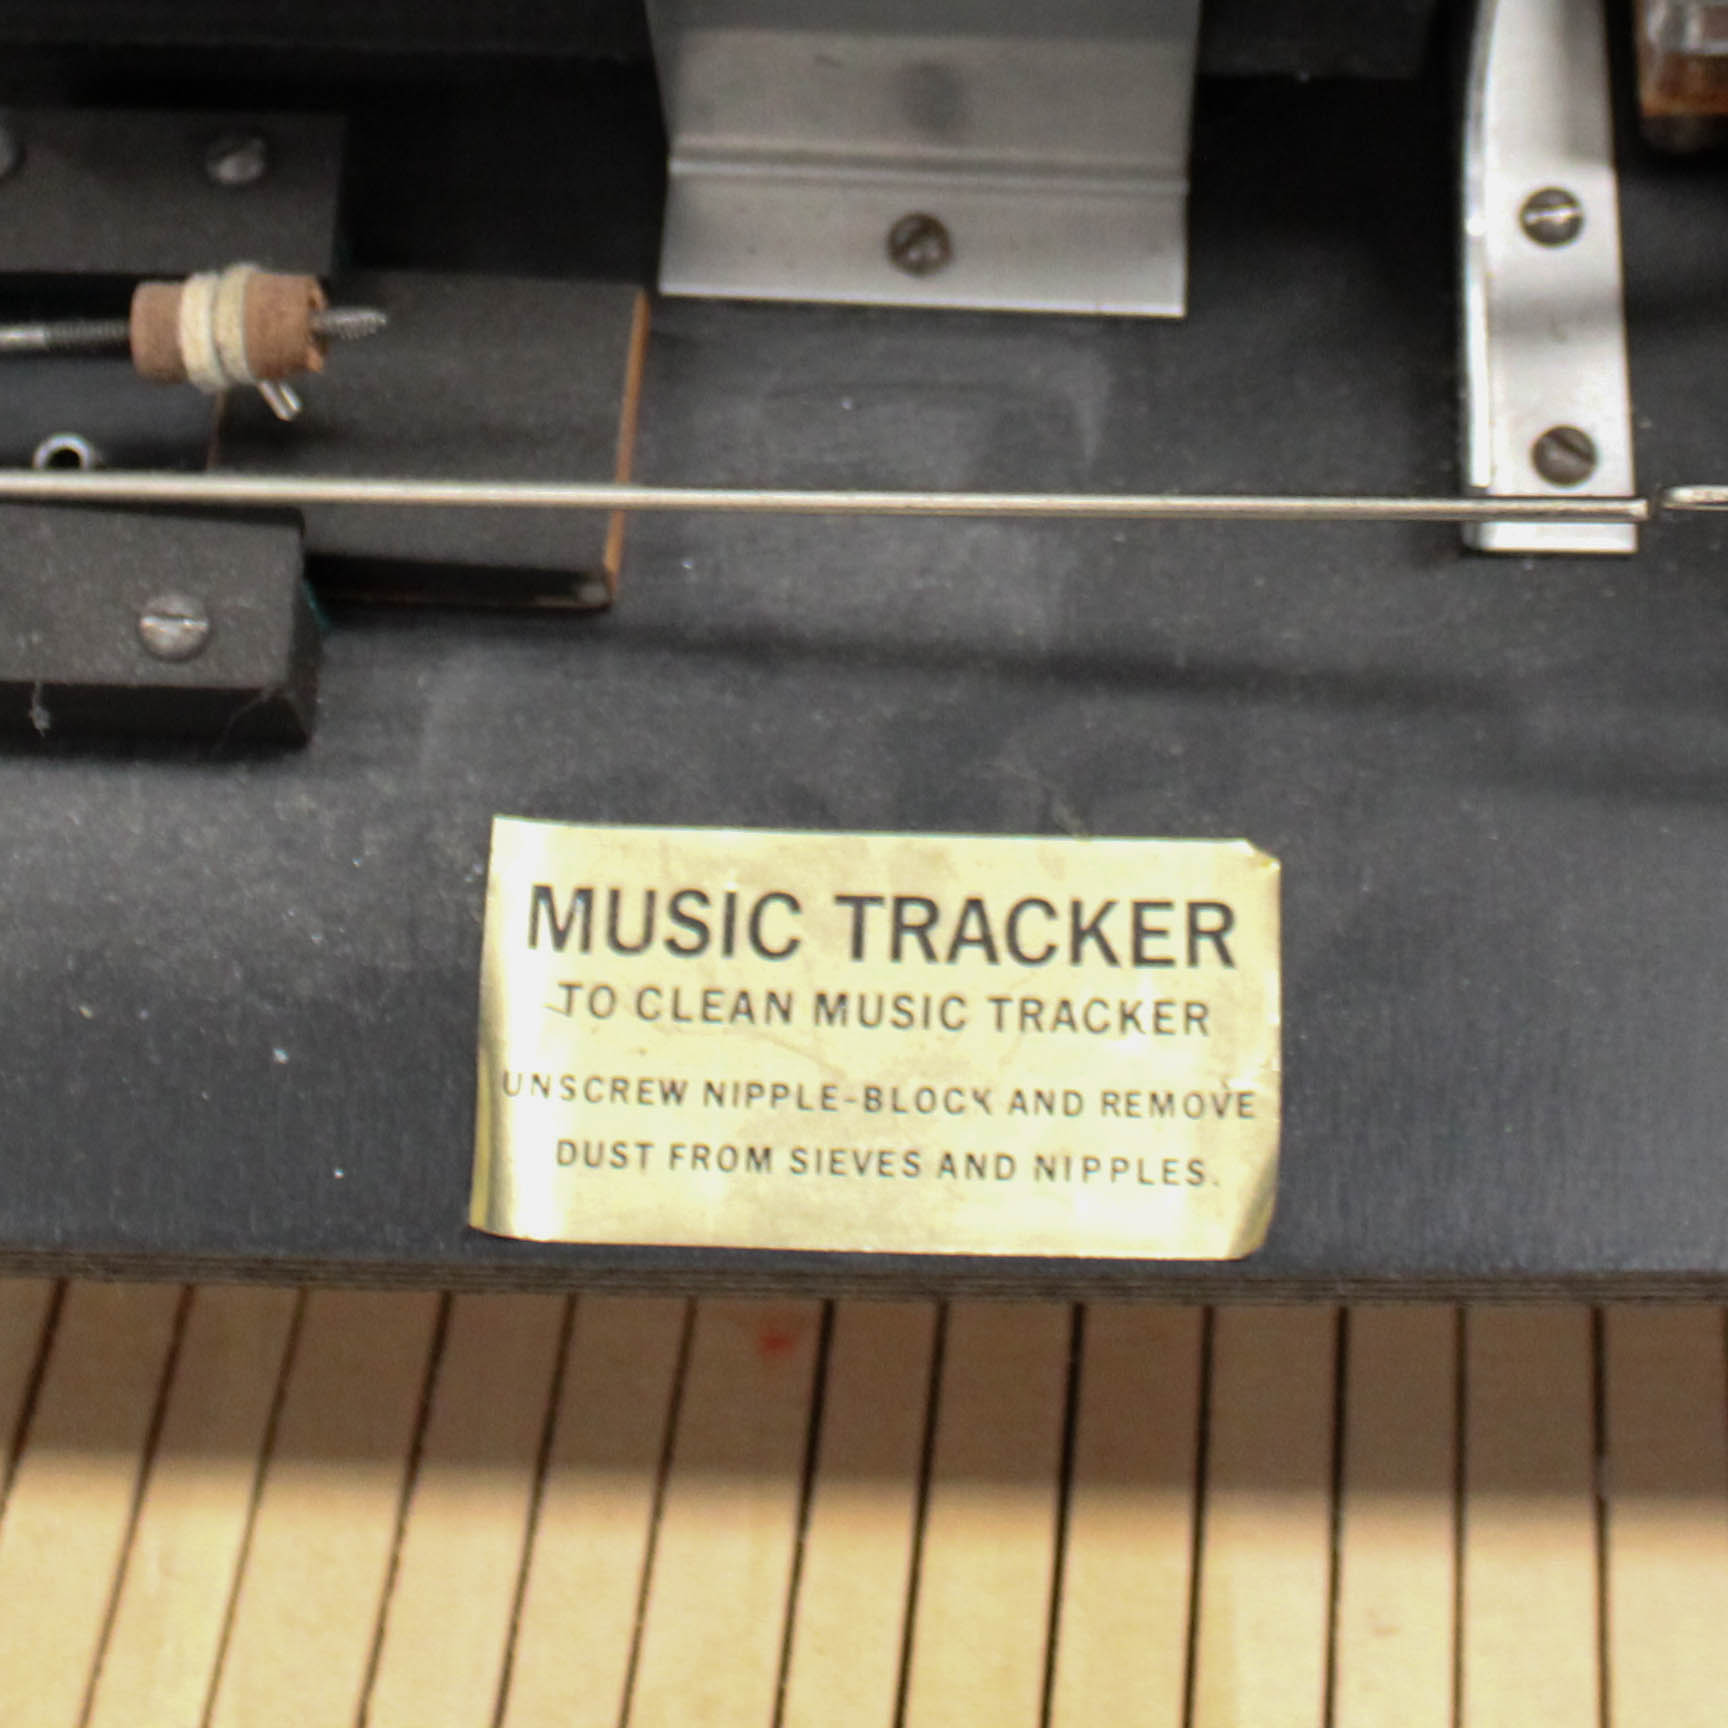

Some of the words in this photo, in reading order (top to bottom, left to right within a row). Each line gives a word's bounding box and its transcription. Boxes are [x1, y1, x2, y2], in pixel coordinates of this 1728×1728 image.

[528, 883, 803, 961] MUSIC
[834, 892, 1238, 970] TRACKER
[557, 981, 617, 1020] TO
[635, 984, 794, 1025] CLEAN
[814, 991, 969, 1032] MUSIC
[986, 996, 1211, 1037] TRACKER
[501, 1071, 689, 1108] UNSCREW
[1007, 1087, 1085, 1119] AND
[1100, 1088, 1258, 1121] REMOVE
[555, 1138, 654, 1170] DUST
[668, 1142, 773, 1176] FROM
[788, 1146, 924, 1179] SIEVES
[936, 1151, 1017, 1183] AND
[1034, 1153, 1221, 1188] NIPPLES.
